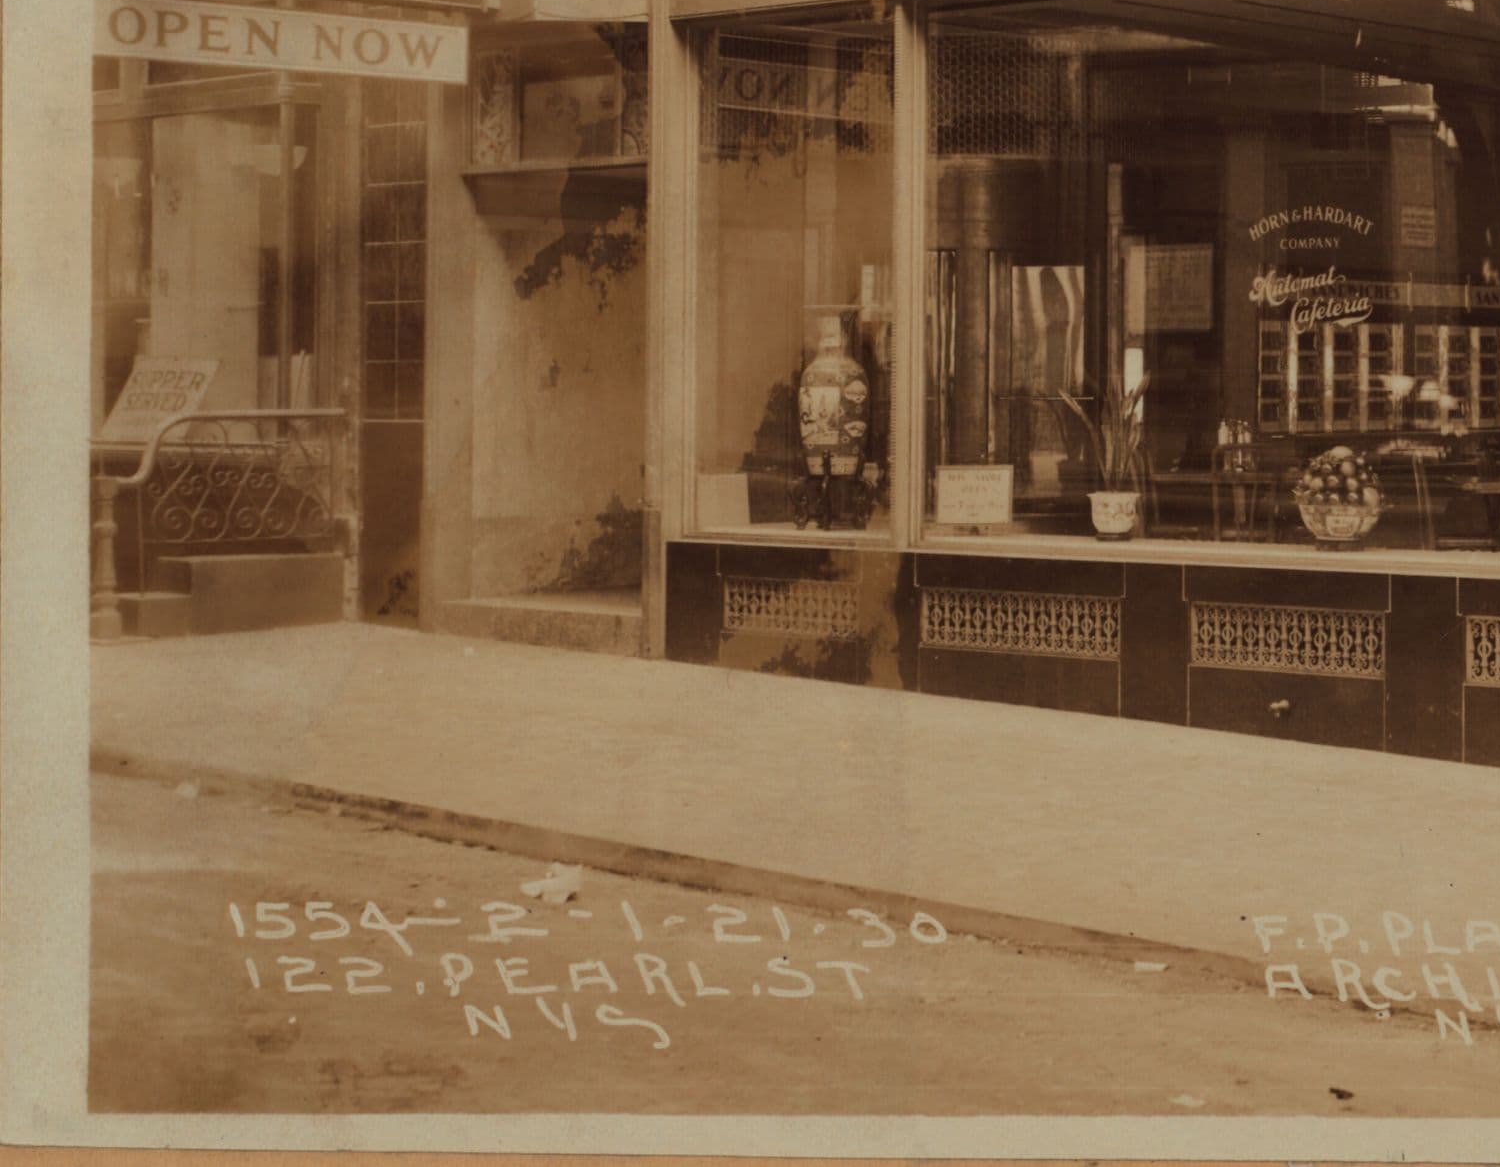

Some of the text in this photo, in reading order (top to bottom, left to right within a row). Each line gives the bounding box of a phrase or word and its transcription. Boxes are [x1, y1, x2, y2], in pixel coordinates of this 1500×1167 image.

[109, 5, 444, 71] OPEN NOW
[1249, 210, 1290, 241] HORN
[1303, 205, 1375, 235] HARDART
[1280, 237, 1340, 249] COMPANY
[1249, 265, 1346, 308] Automat
[1289, 292, 1373, 335] Cafeteria
